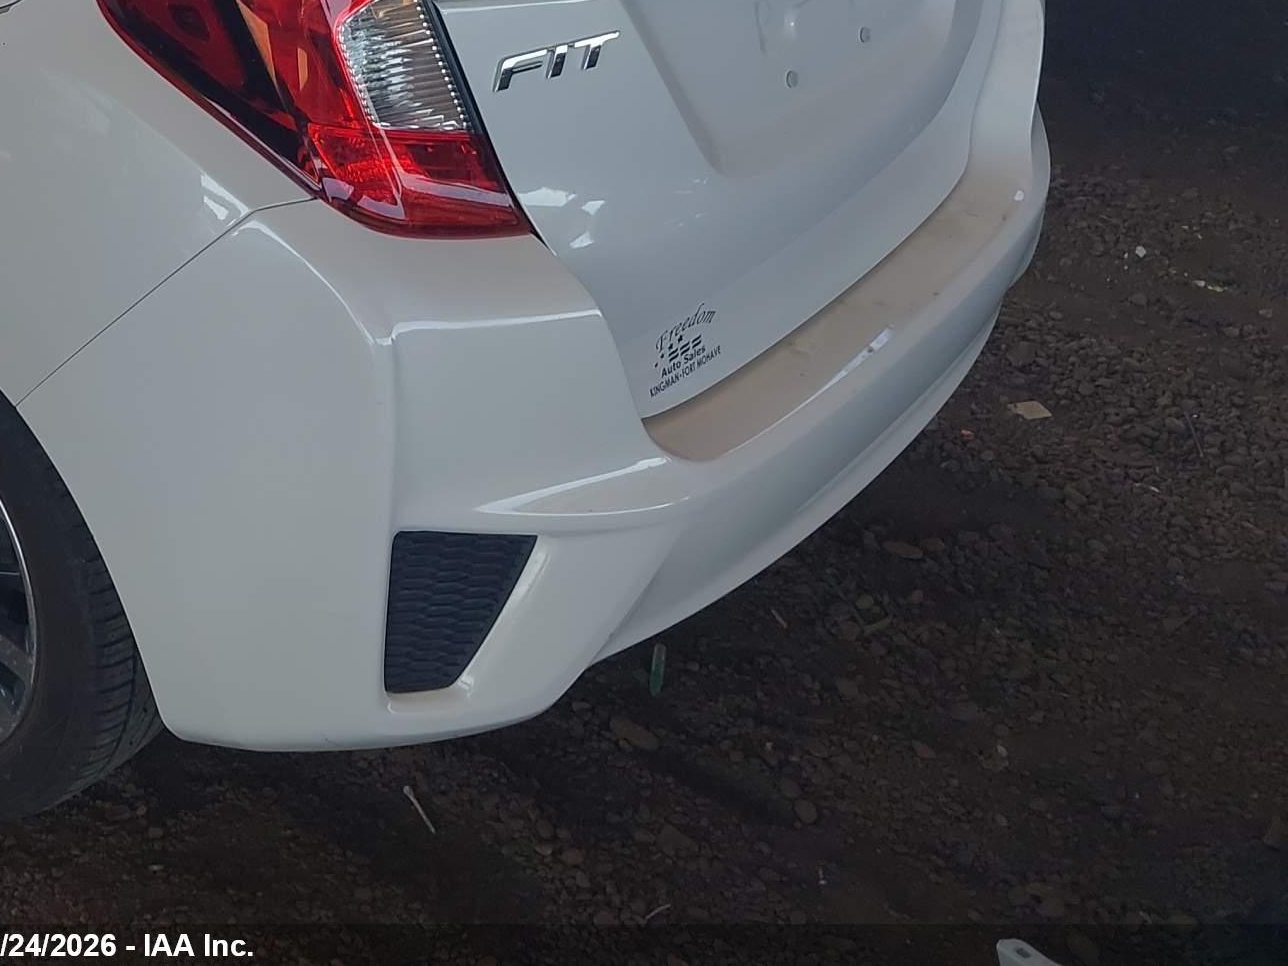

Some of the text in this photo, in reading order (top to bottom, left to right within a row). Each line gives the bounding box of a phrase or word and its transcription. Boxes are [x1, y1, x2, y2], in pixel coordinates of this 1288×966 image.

[493, 30, 621, 92] FIT
[655, 302, 716, 353] Freedom
[661, 345, 706, 379] Auto Sales
[697, 345, 721, 369] MOHAVE
